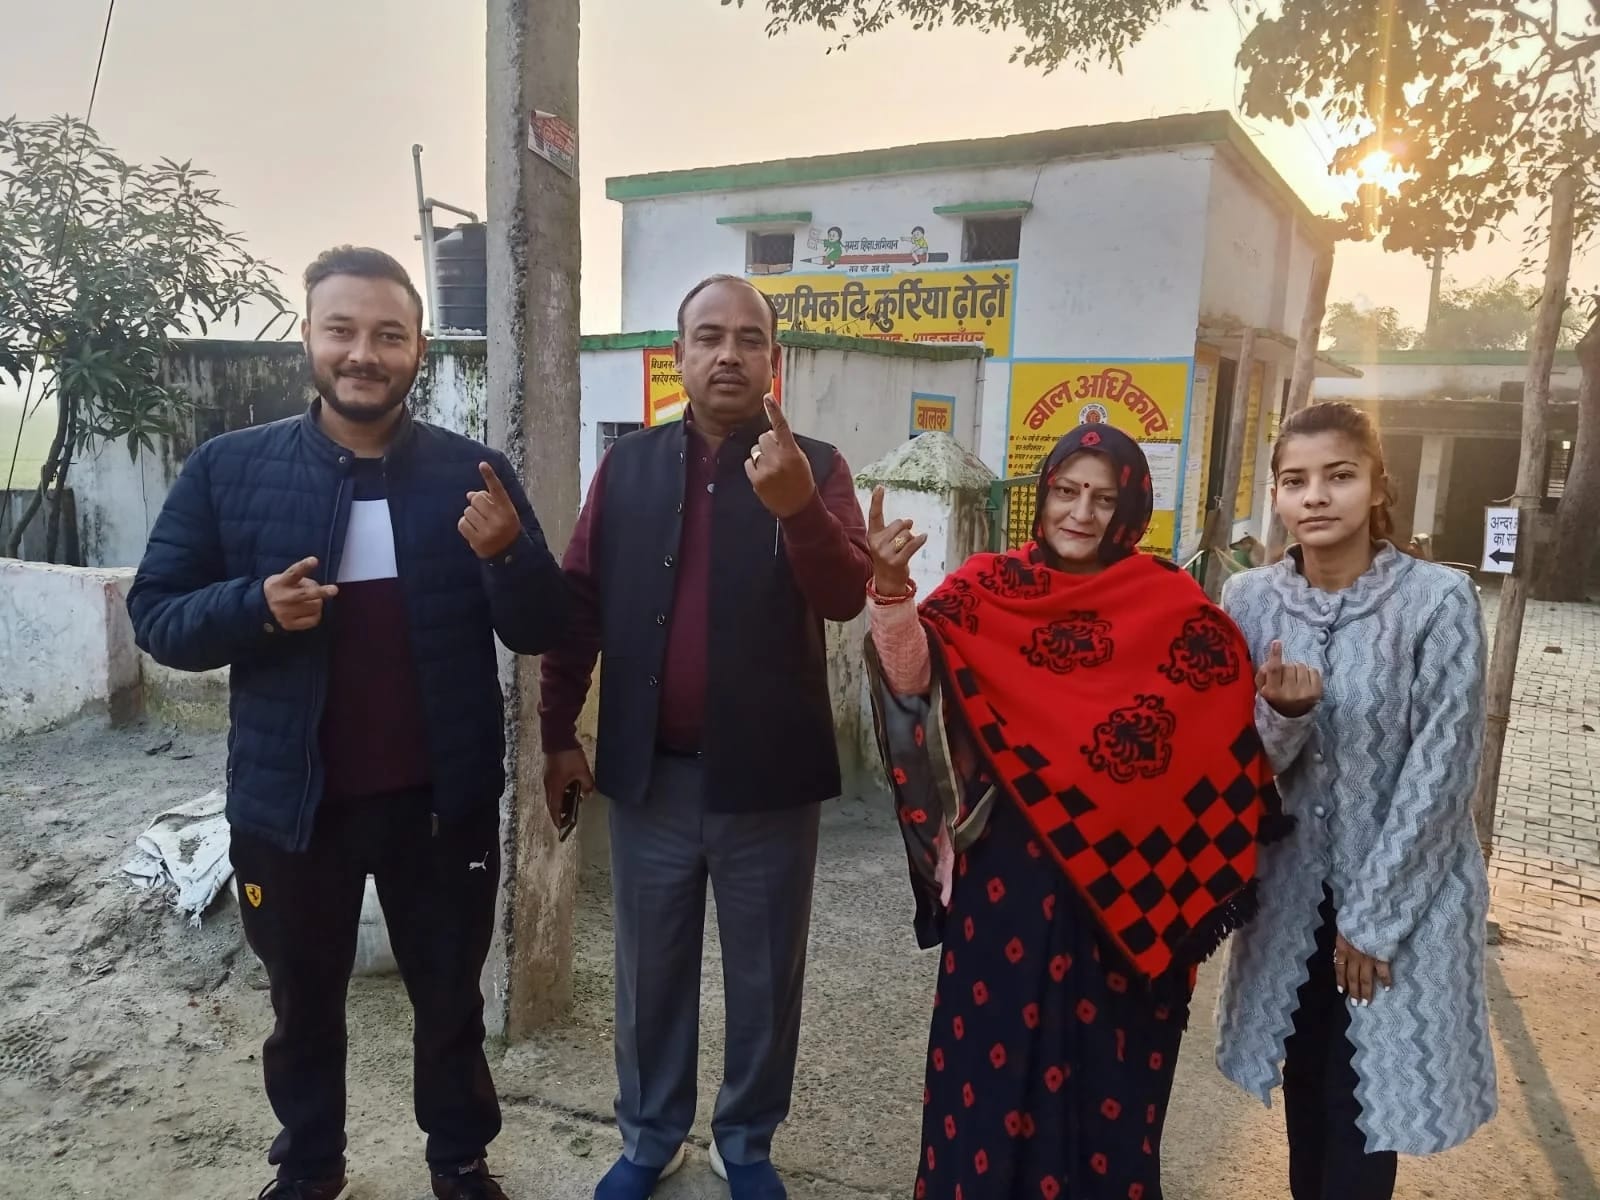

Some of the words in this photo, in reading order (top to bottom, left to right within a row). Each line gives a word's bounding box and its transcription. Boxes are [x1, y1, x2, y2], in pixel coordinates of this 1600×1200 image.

[766, 285, 839, 323] थमिक
[1023, 380, 1073, 431] बाल
[1074, 367, 1169, 436] अधिकार
[918, 406, 948, 430] बालक
[1490, 517, 1513, 530] अन्दर
[1494, 533, 1505, 546] का
